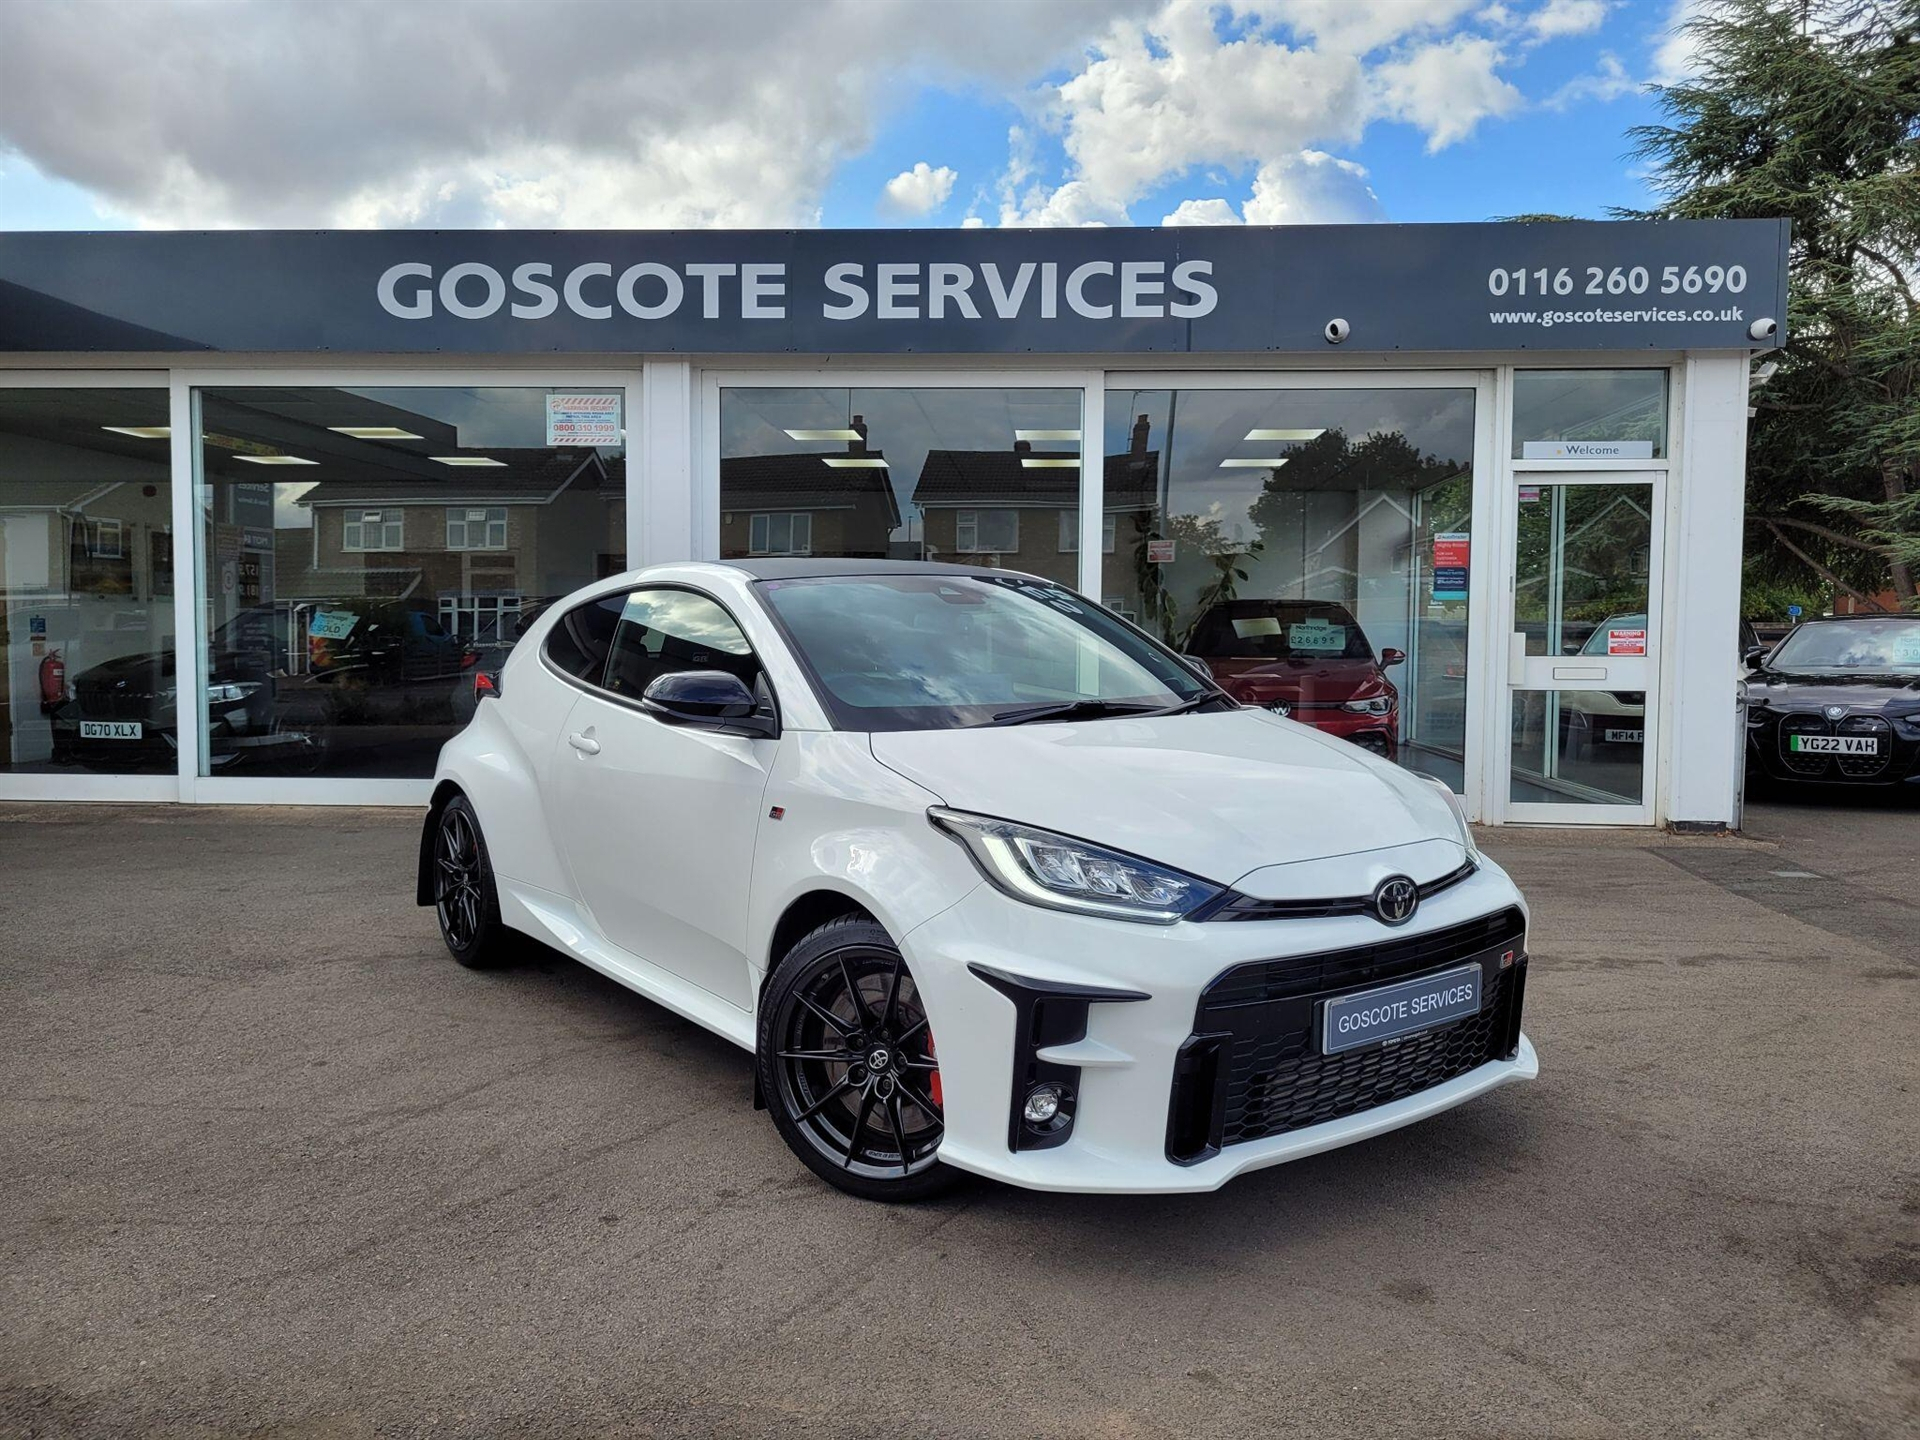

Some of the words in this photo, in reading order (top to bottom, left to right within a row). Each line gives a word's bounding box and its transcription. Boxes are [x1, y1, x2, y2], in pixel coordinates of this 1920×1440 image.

[1488, 267, 1574, 296] 0116
[1585, 266, 1649, 295] 260
[1660, 265, 1747, 294] 5690
[377, 262, 786, 320] GOSCOTE
[823, 260, 1219, 320] SERVICES
[1489, 306, 1743, 327] www.goscoteservices.co.uk
[553, 424, 576, 432] 0800
[577, 424, 592, 432] 310
[594, 424, 615, 432] 1999
[1566, 445, 1620, 455] Welcome
[316, 624, 341, 634] SOLD
[84, 723, 111, 736] DG70
[113, 724, 137, 737] XLX
[1801, 737, 1840, 751] YG22
[1844, 739, 1875, 752] VAH
[1338, 1000, 1408, 1033] GOSCOTE
[1410, 983, 1473, 1015] SERVICES
